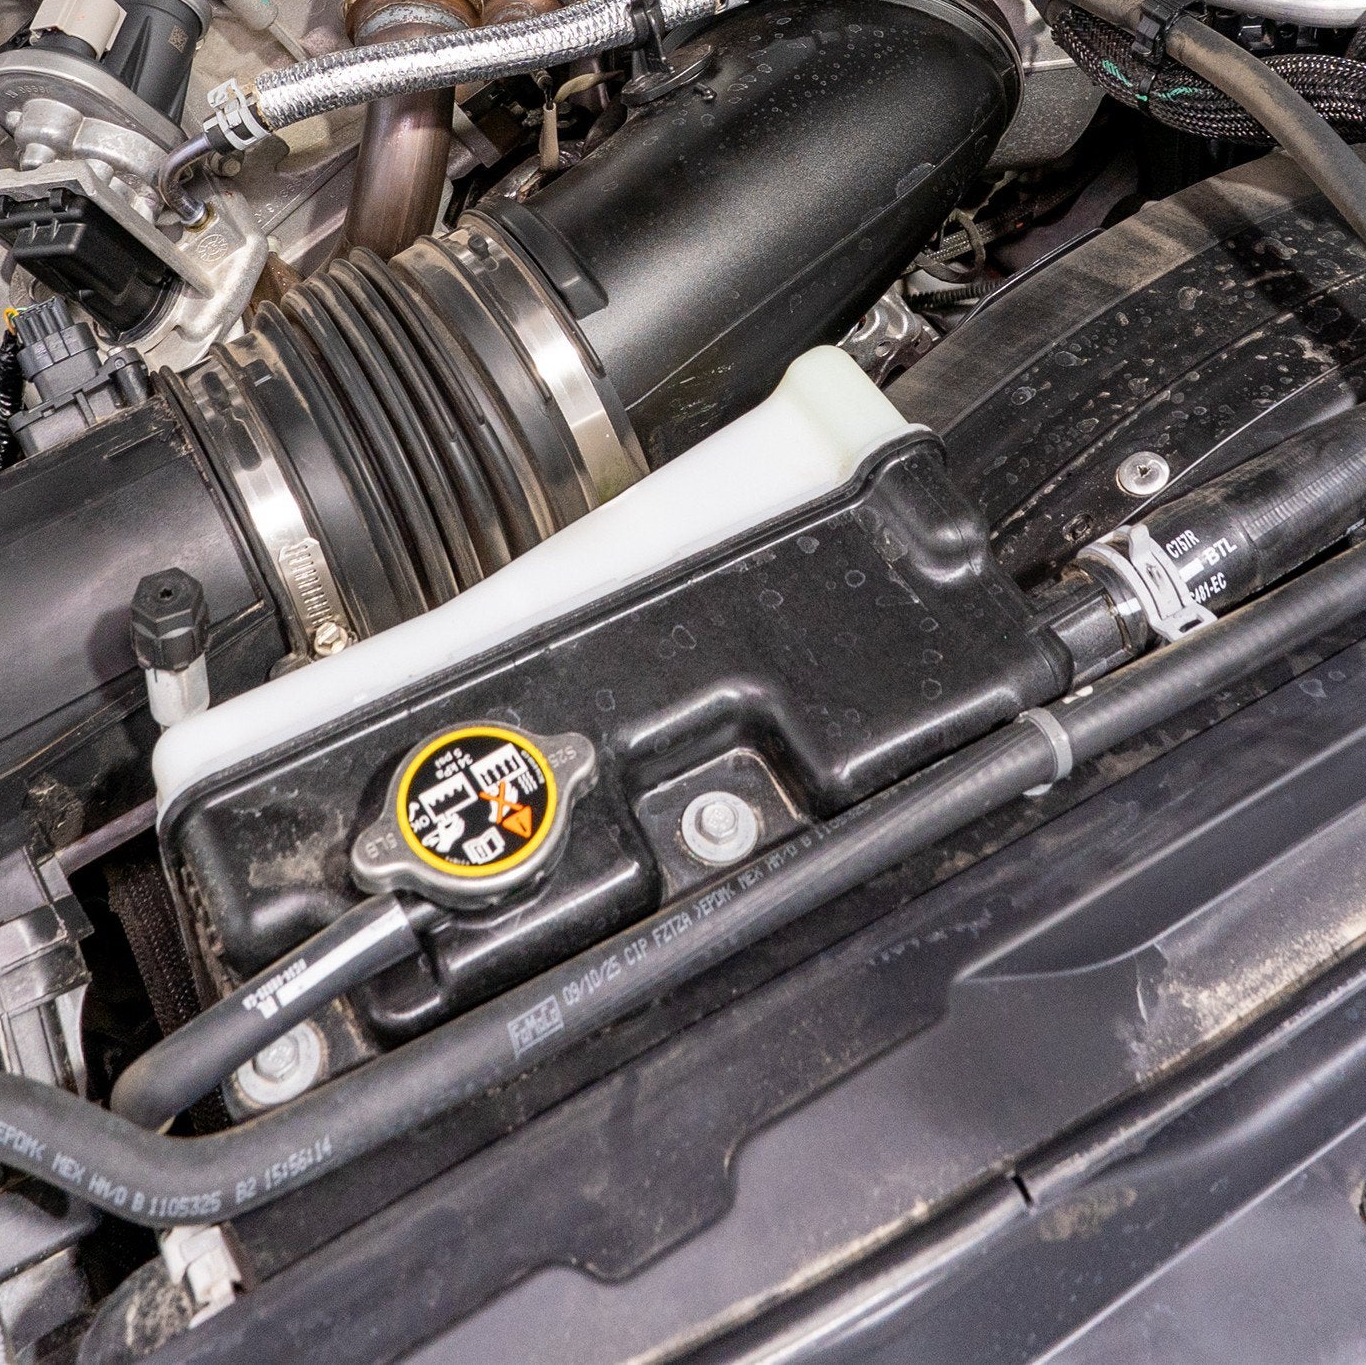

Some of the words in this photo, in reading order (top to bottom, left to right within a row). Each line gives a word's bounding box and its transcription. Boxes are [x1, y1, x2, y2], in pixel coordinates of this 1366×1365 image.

[1165, 530, 1199, 560] C757R
[1205, 539, 1238, 567] BTL
[432, 750, 454, 768] psi
[451, 746, 463, 758] 5
[455, 751, 474, 769] 34
[433, 760, 459, 781] kPa
[407, 813, 431, 833] OK
